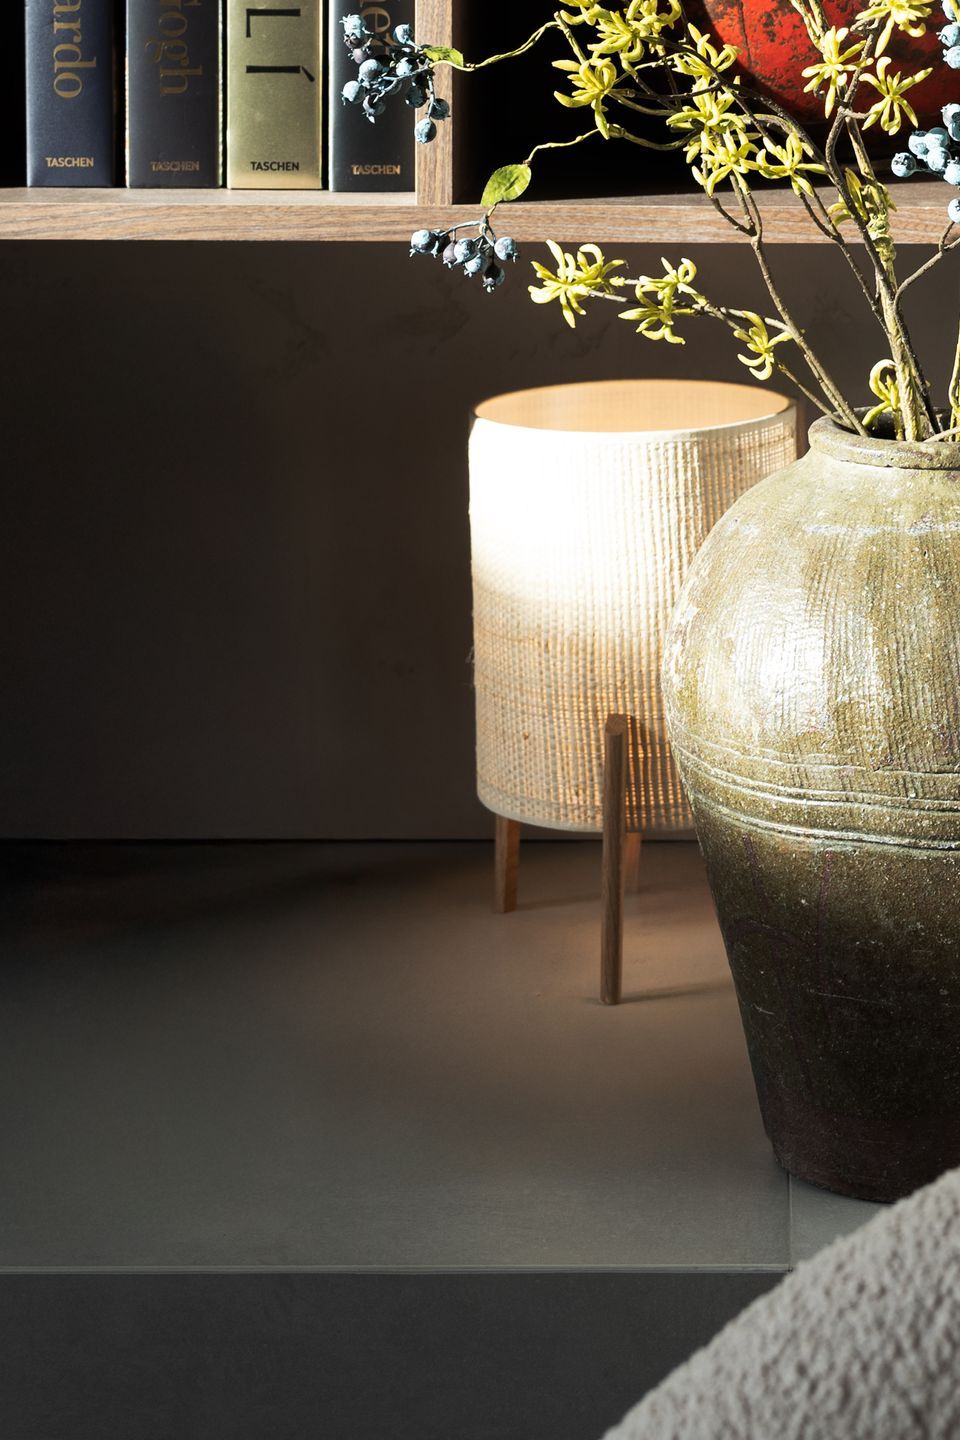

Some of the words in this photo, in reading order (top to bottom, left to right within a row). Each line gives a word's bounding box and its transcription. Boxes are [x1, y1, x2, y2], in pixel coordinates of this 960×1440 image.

[45, 156, 95, 168] TASCHEN
[150, 160, 200, 172] TASCHEN
[250, 161, 300, 172] TASCHEN
[352, 164, 401, 175] TASCHEN
